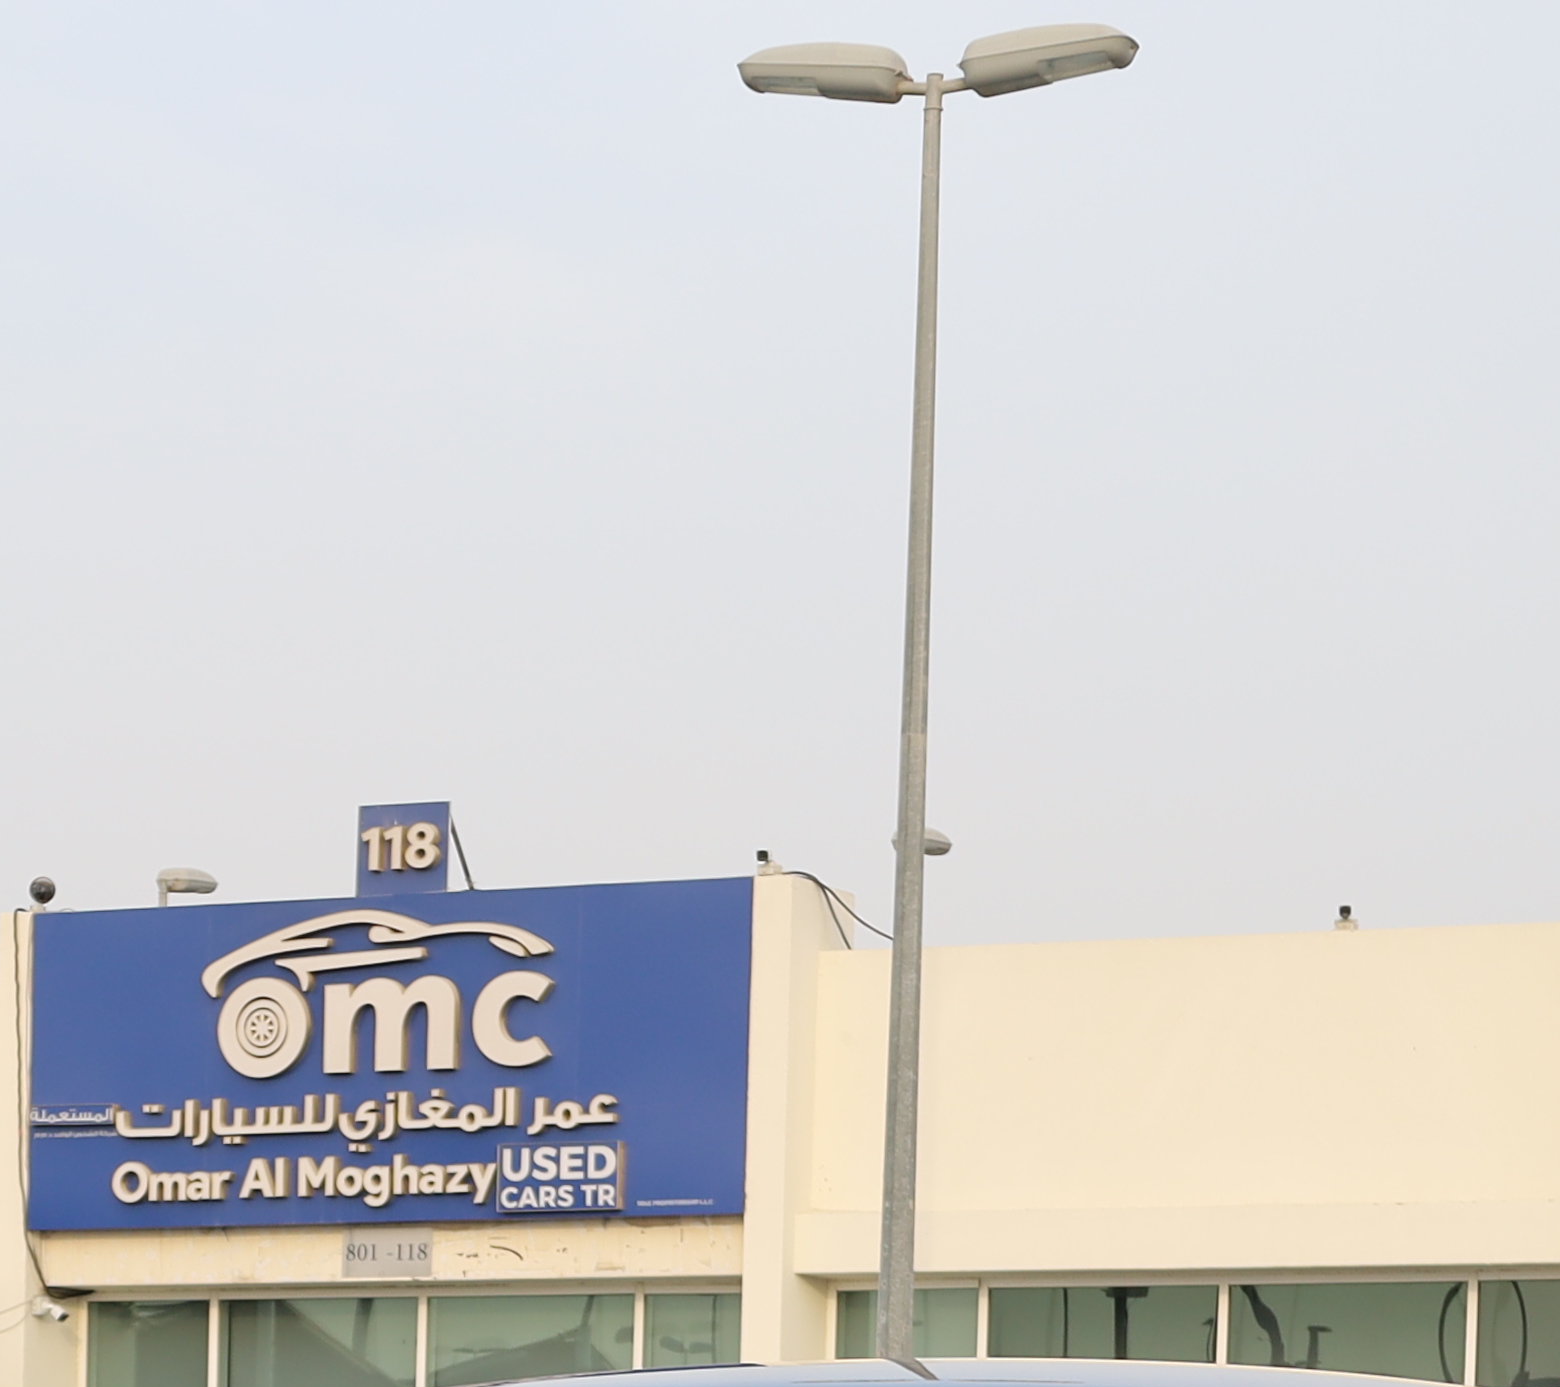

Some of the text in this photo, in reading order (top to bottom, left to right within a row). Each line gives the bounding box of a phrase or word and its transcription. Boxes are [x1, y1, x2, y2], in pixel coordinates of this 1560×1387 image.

[361, 821, 441, 872] 118
[115, 1093, 341, 1147] للسيارات
[337, 1086, 522, 1154] المغازي
[526, 1093, 621, 1136] عمر
[111, 1145, 618, 1208] Omar Al Moghazy USED
[499, 1184, 574, 1209] CARS
[579, 1183, 616, 1207] TR
[345, 1242, 378, 1263] 801
